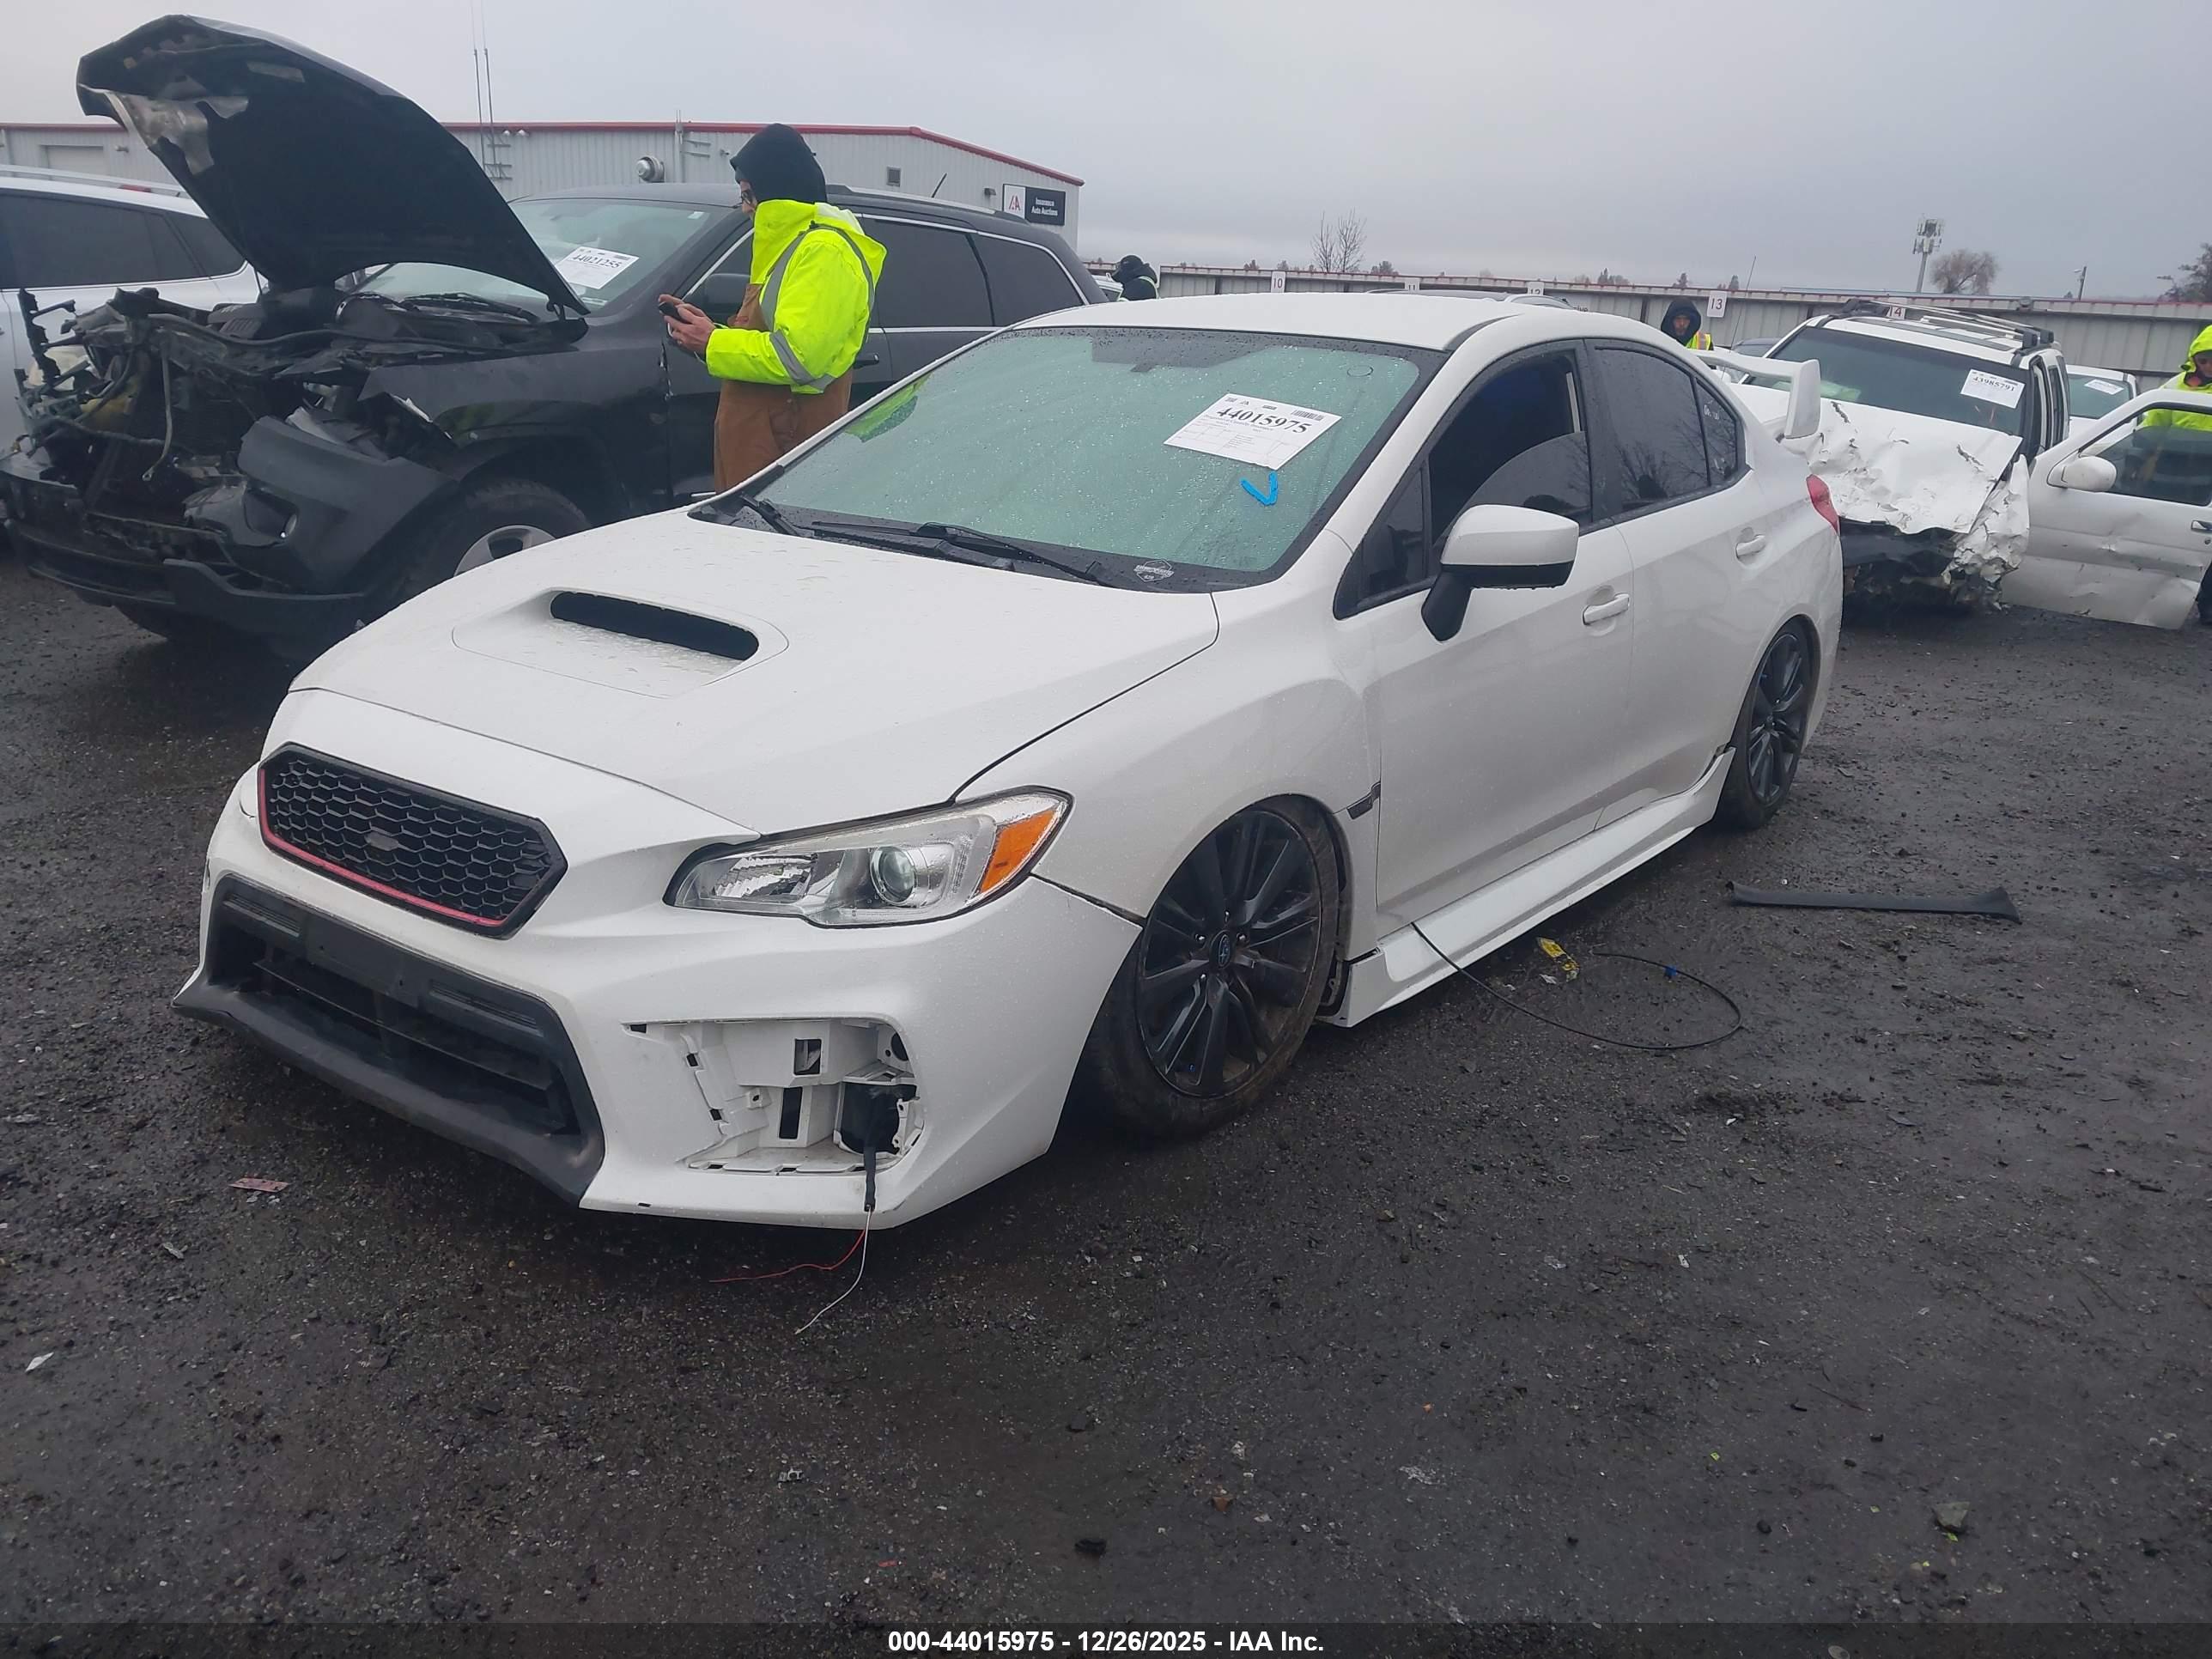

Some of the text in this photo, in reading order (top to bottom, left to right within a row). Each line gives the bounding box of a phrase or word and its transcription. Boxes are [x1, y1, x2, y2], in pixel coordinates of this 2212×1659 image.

[1273, 277, 1283, 289] 10
[1711, 297, 1723, 310] 13
[1216, 407, 1313, 434] 44015975
